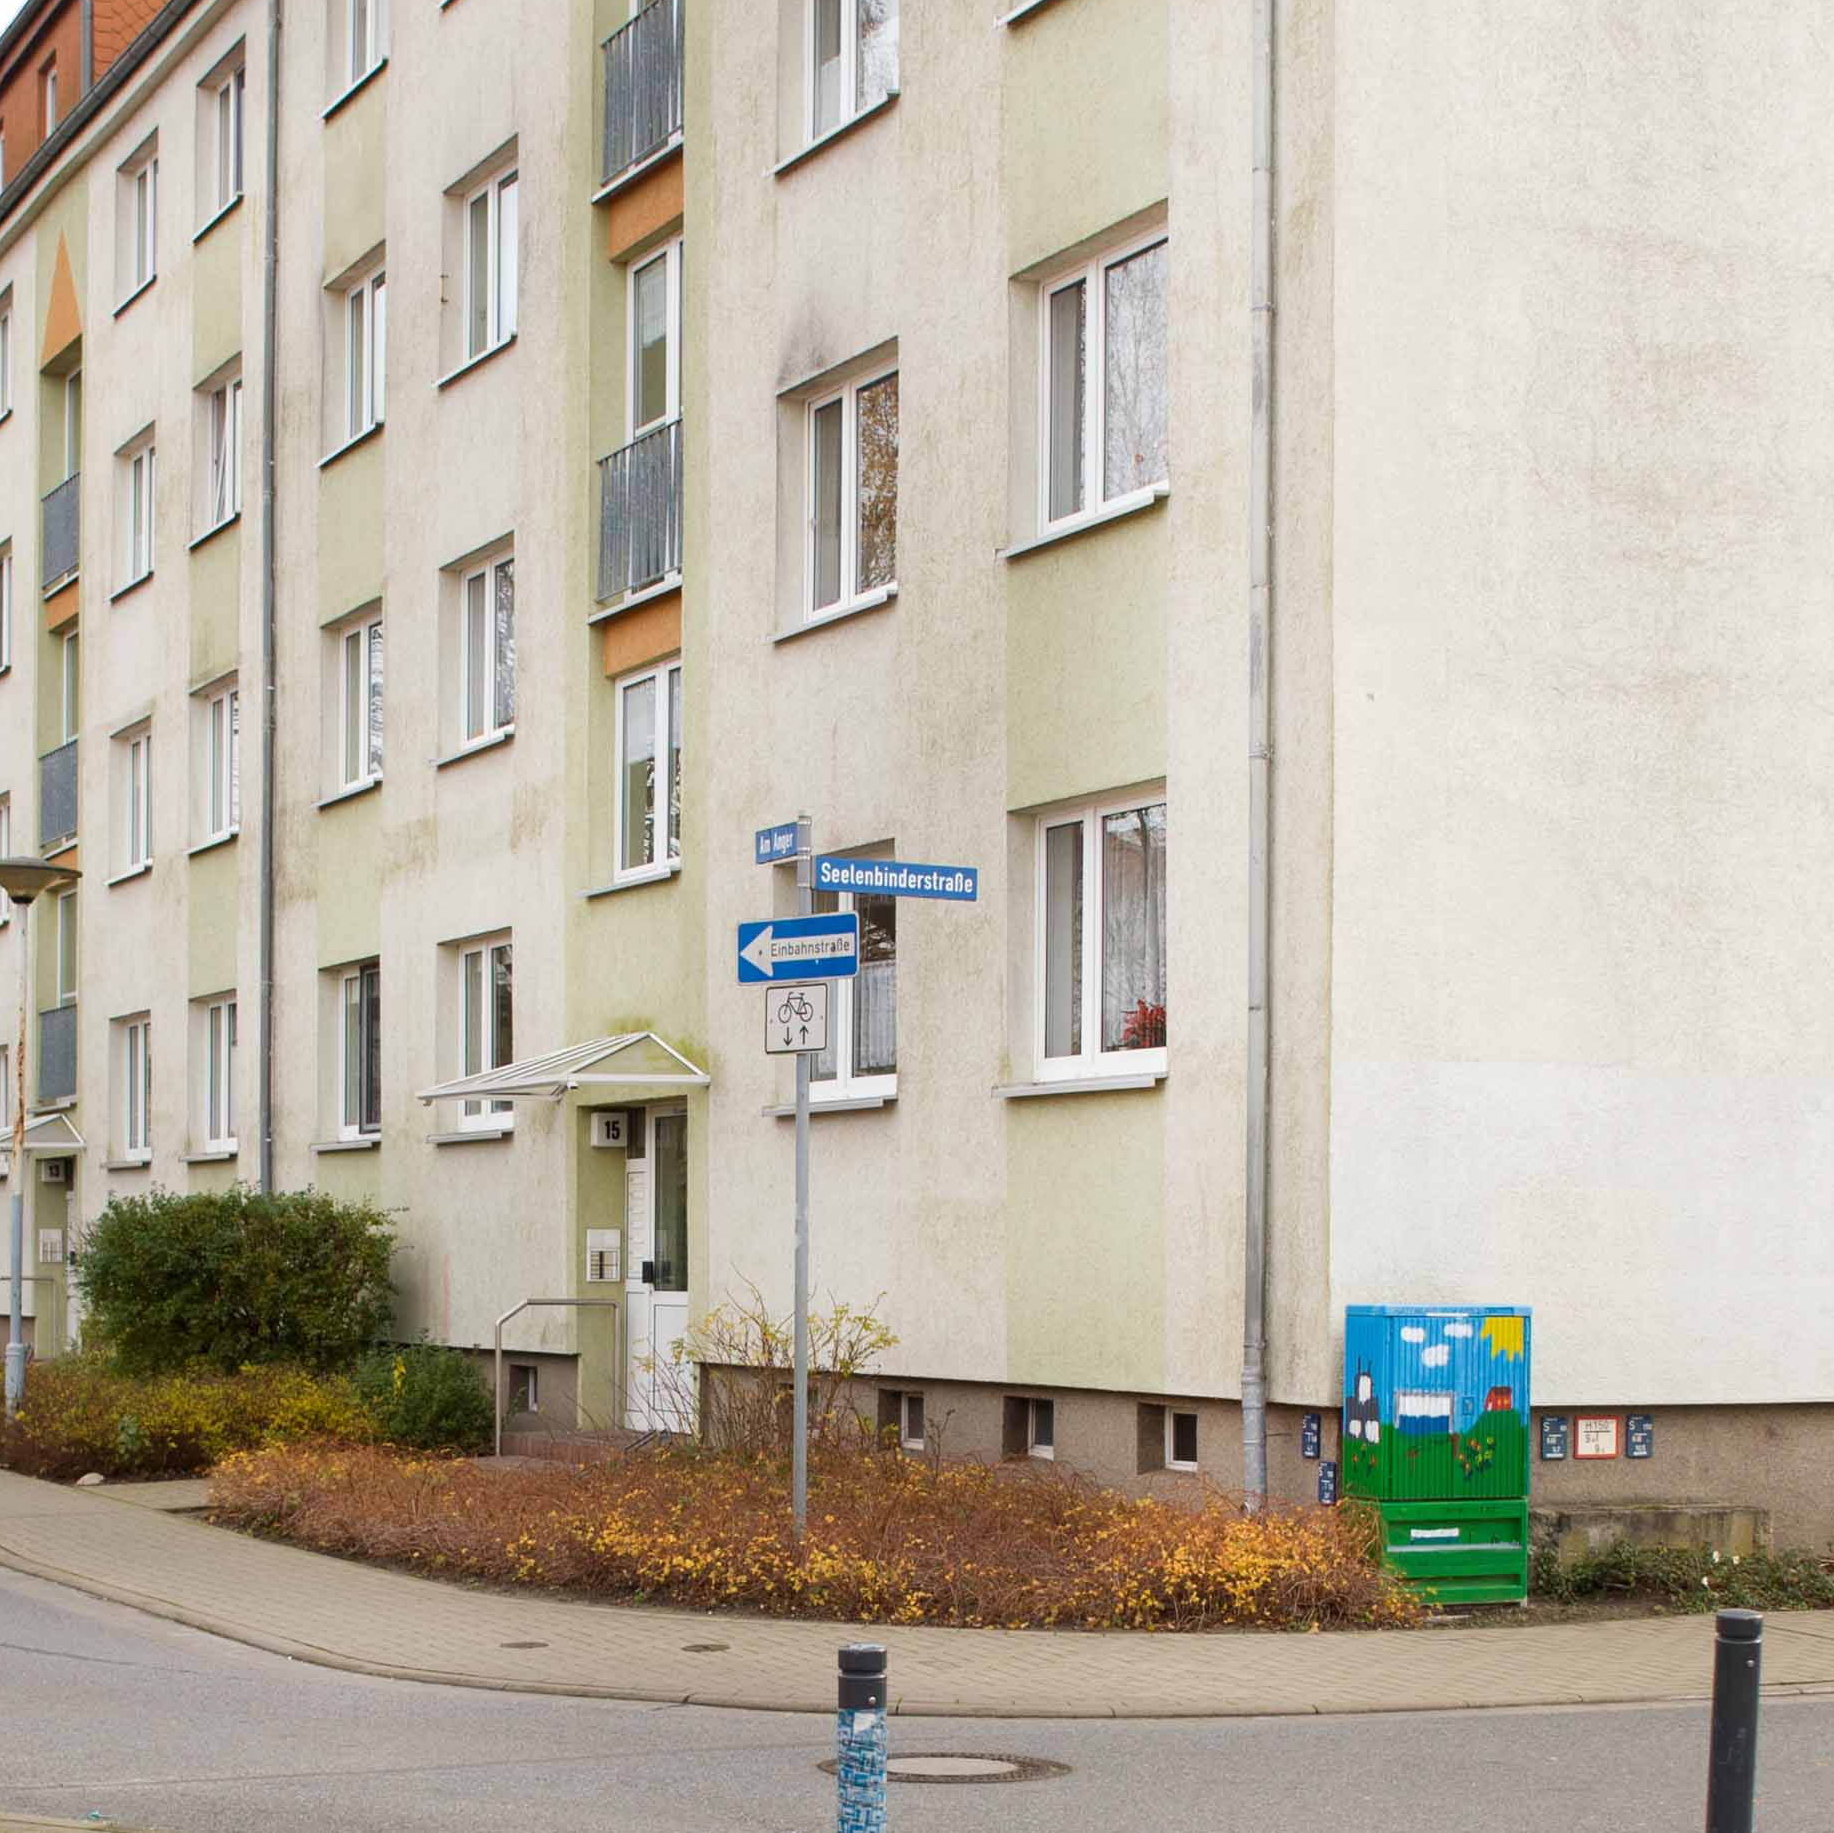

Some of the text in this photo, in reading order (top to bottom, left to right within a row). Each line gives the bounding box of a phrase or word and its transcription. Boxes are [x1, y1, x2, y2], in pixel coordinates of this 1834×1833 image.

[759, 832, 793, 855] Am Anger
[821, 862, 973, 893] Seelenbinderstraße
[770, 937, 850, 957] Einbahnstraße
[604, 1120, 620, 1140] 15
